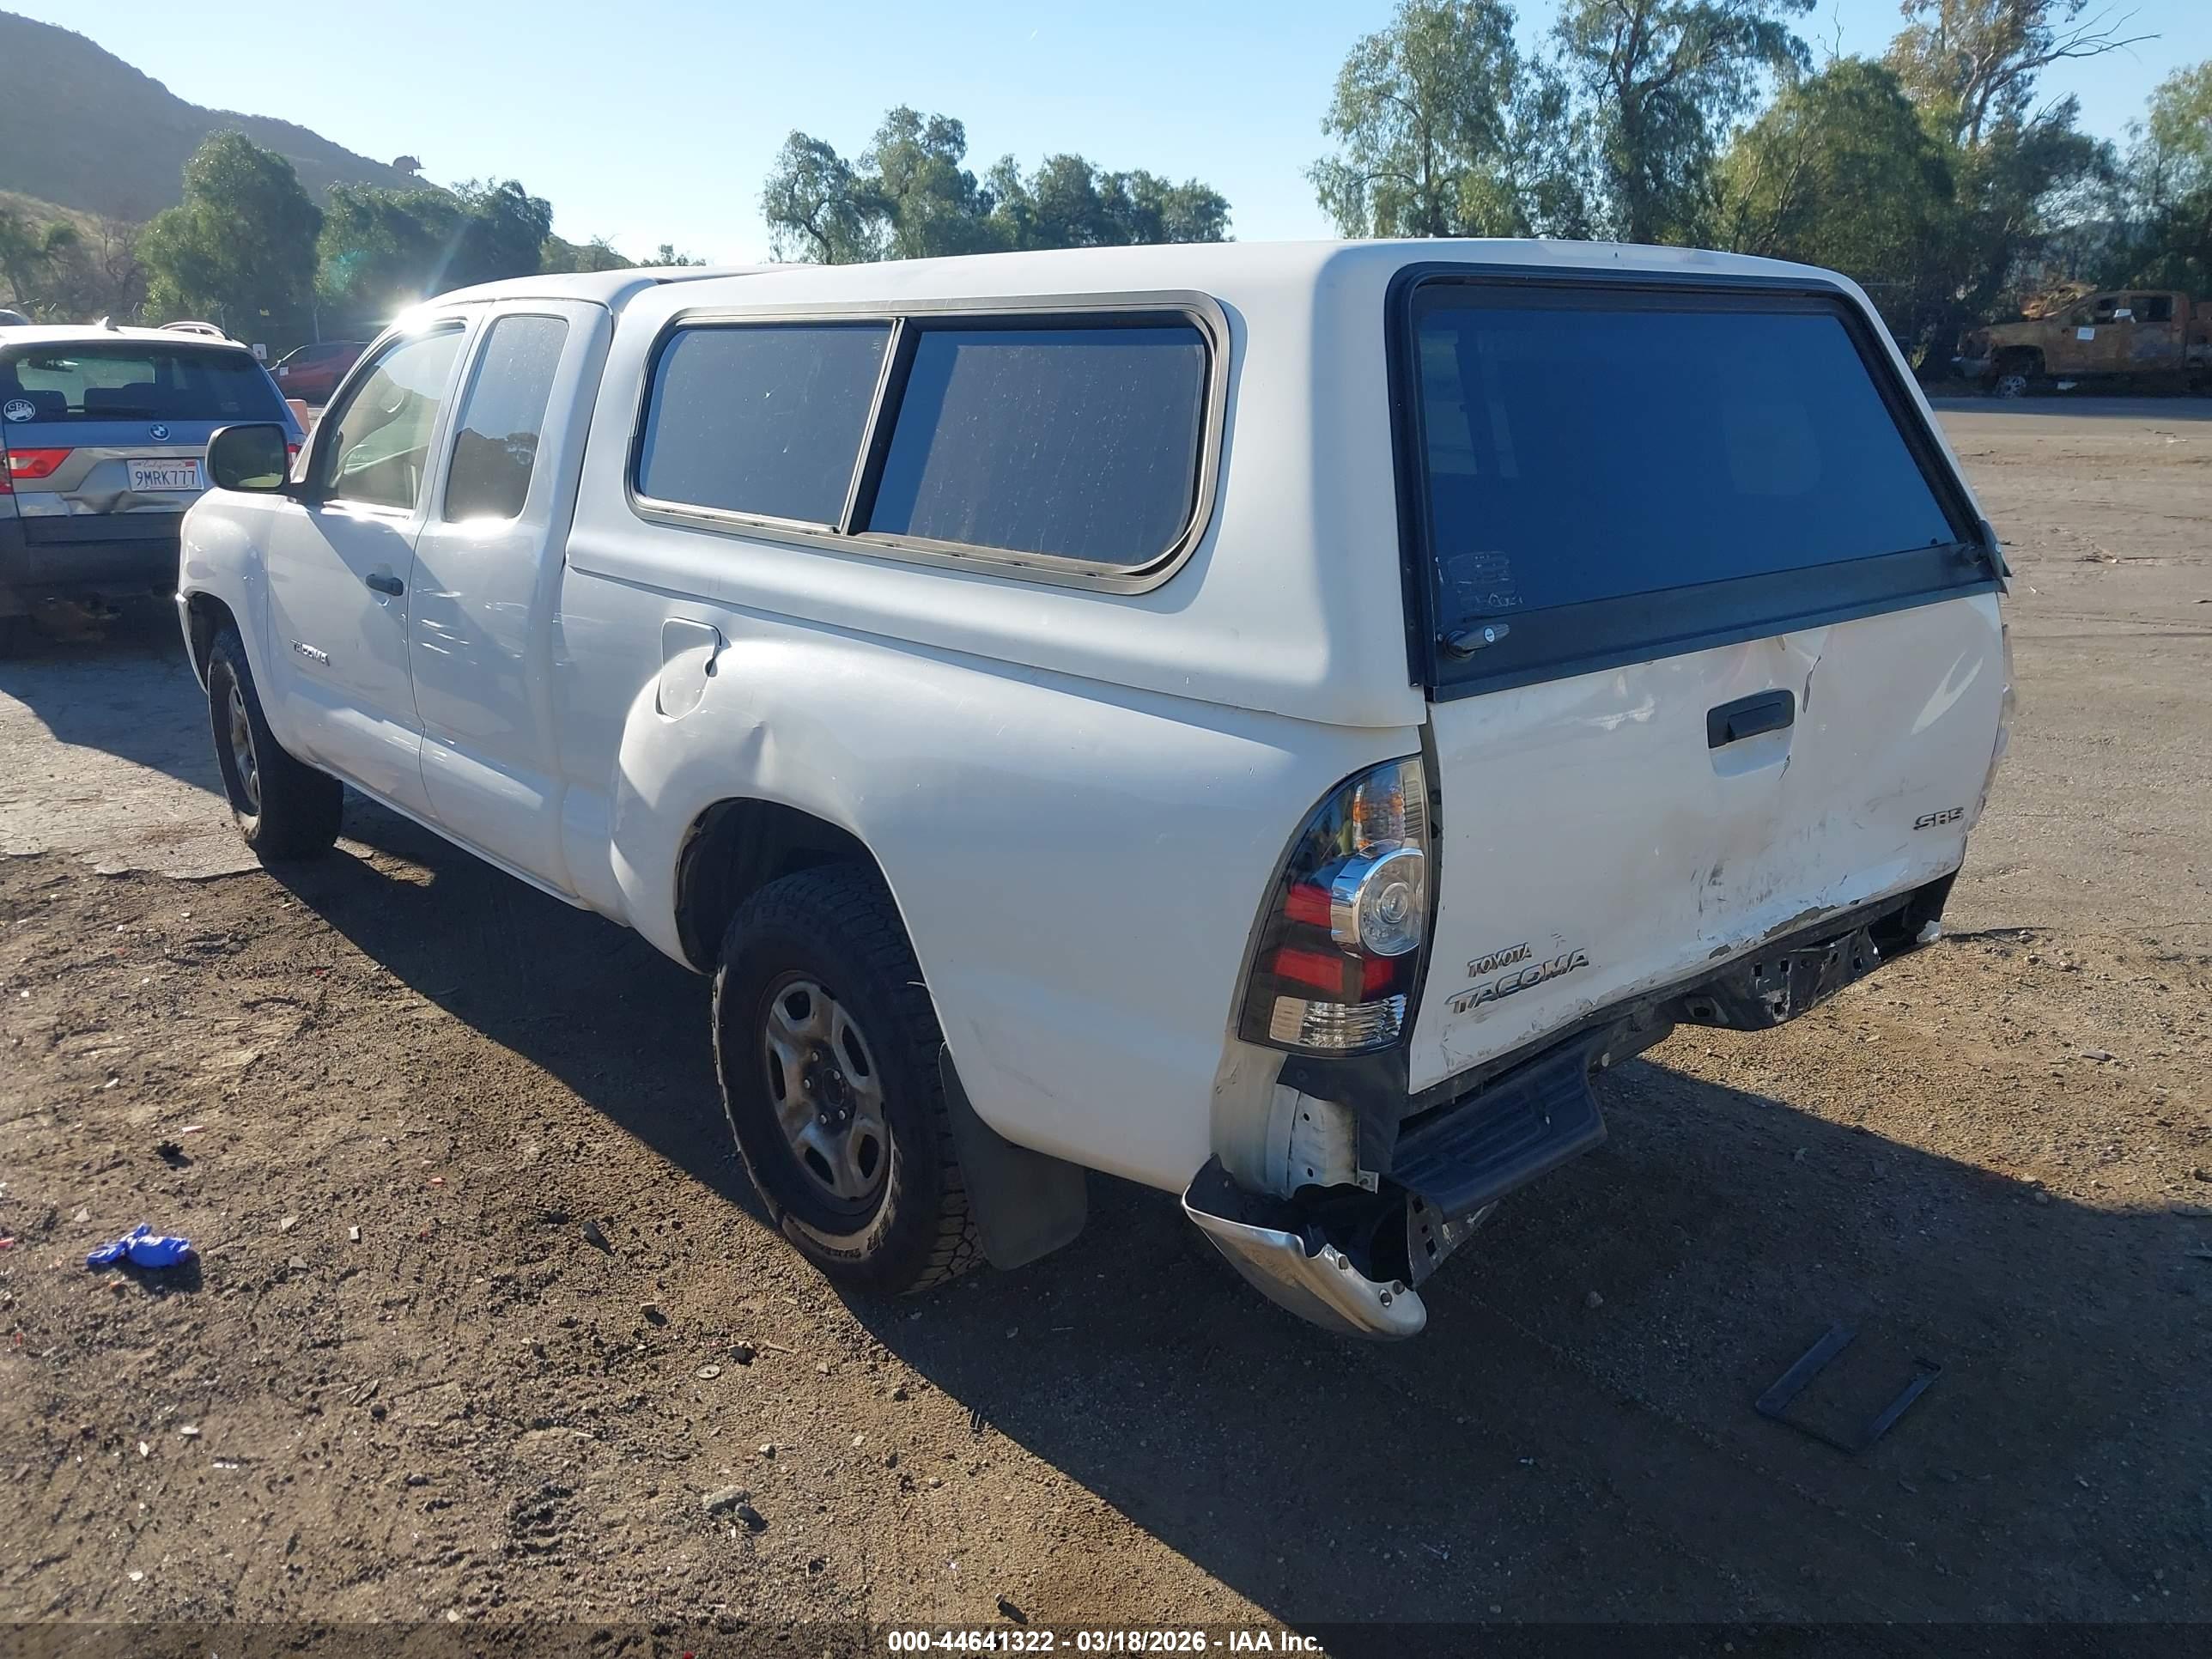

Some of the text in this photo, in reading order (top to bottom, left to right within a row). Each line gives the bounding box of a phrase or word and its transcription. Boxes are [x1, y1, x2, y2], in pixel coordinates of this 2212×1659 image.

[135, 470, 196, 486] 9MRK777
[289, 638, 331, 666] TACOMA
[1913, 806, 1965, 831] SR5
[1468, 941, 1533, 978] TOYOTA
[1444, 948, 1589, 1014] TACOMA
